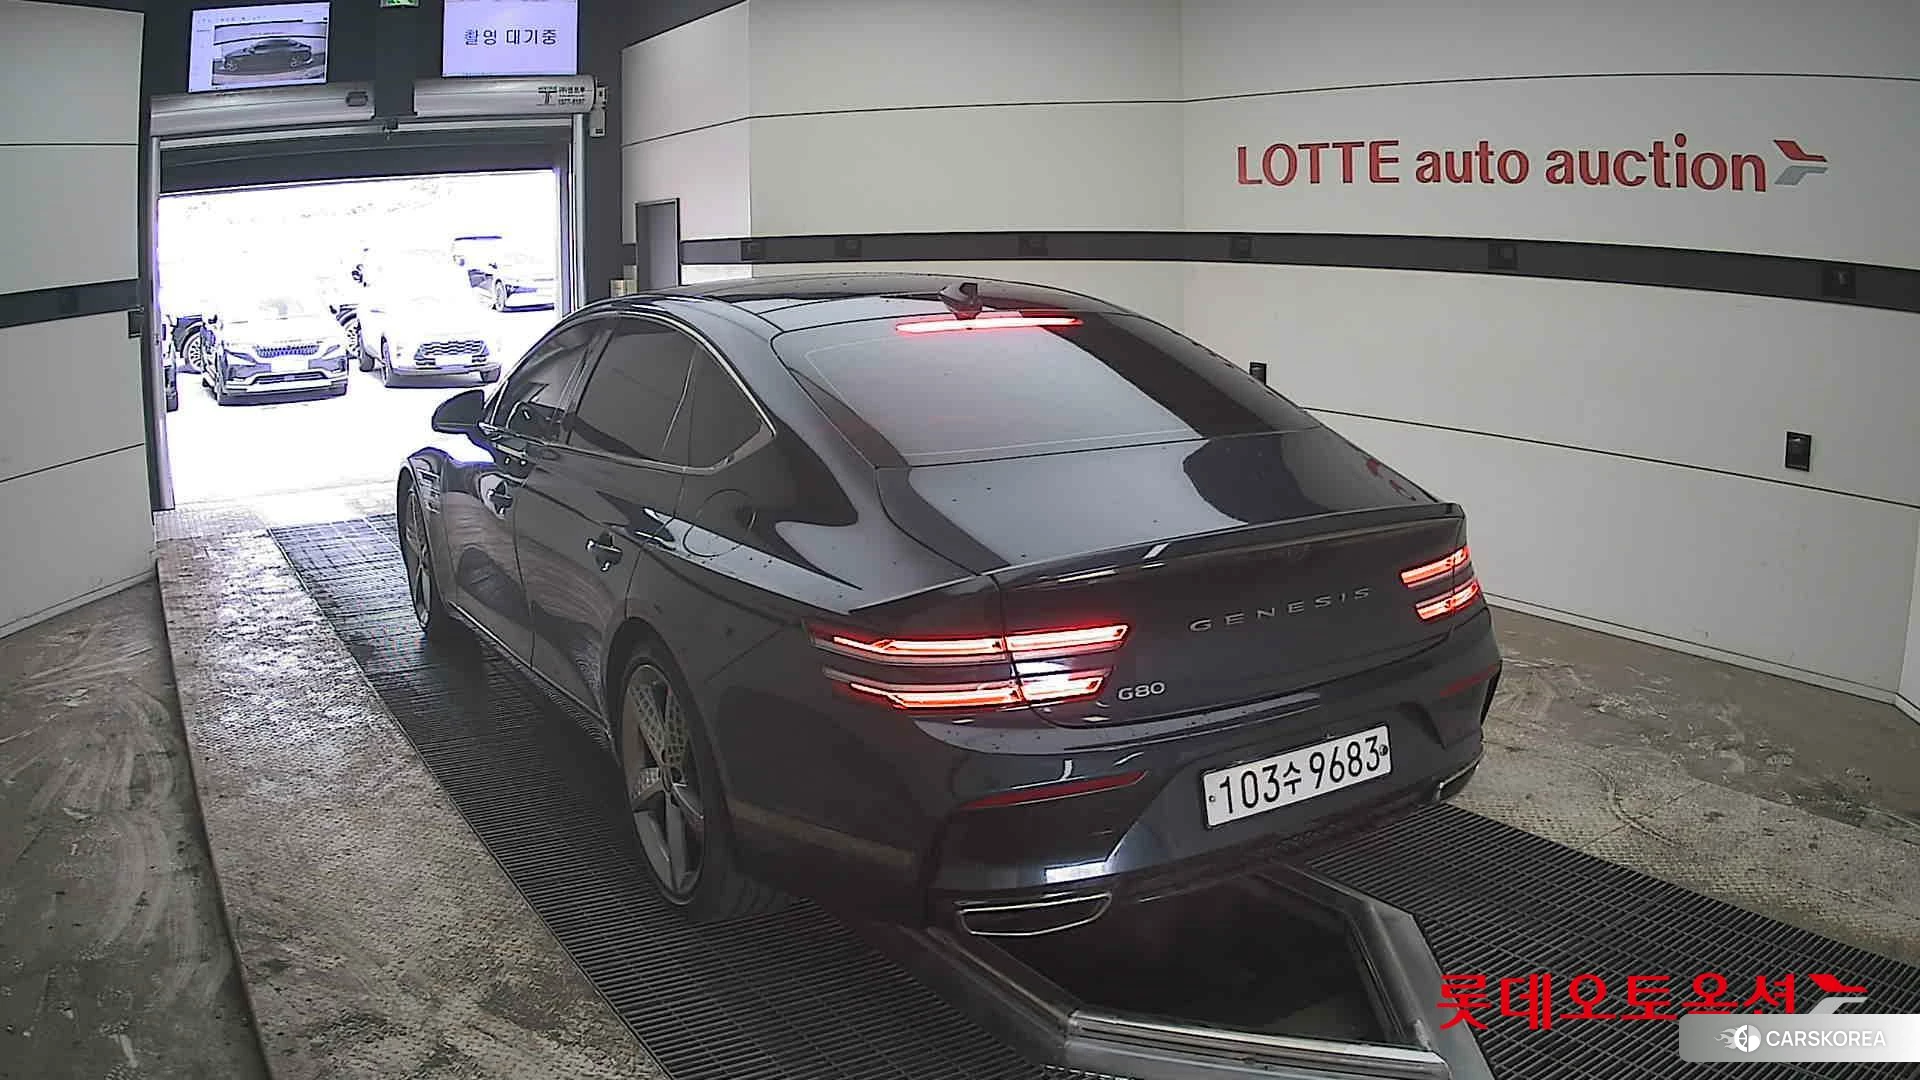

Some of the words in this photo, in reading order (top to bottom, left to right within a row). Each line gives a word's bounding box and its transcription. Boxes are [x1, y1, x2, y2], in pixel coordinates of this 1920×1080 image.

[506, 29, 557, 46] 대기중
[1237, 139, 1399, 186] LOTTE
[1416, 139, 1530, 185] auto
[1546, 133, 1767, 192] auction
[1189, 587, 1371, 632] GENESIS
[1118, 681, 1166, 701] G80
